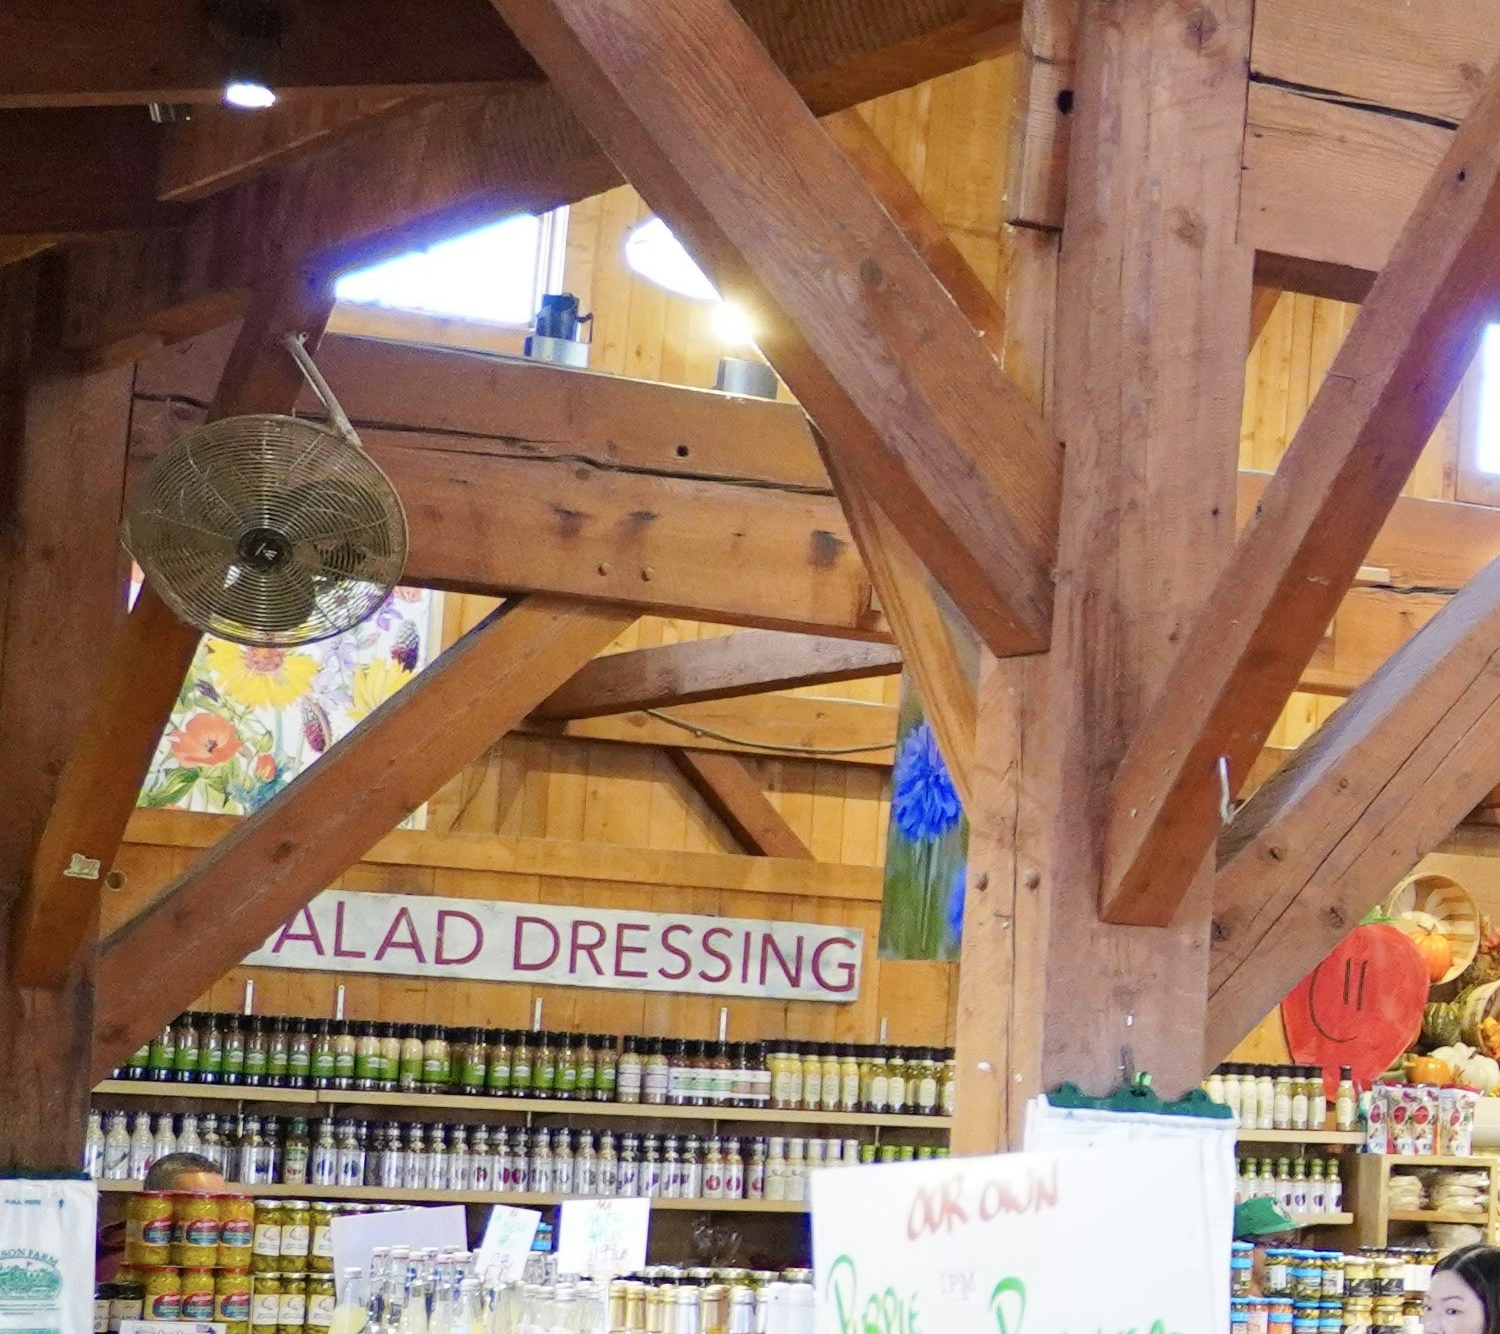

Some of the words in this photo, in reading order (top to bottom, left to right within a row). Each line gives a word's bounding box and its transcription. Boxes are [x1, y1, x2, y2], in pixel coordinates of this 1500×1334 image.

[272, 901, 484, 966] ALAD
[512, 914, 858, 993] DRESSING
[908, 1169, 971, 1242] OUR
[979, 1157, 1059, 1222] OWN
